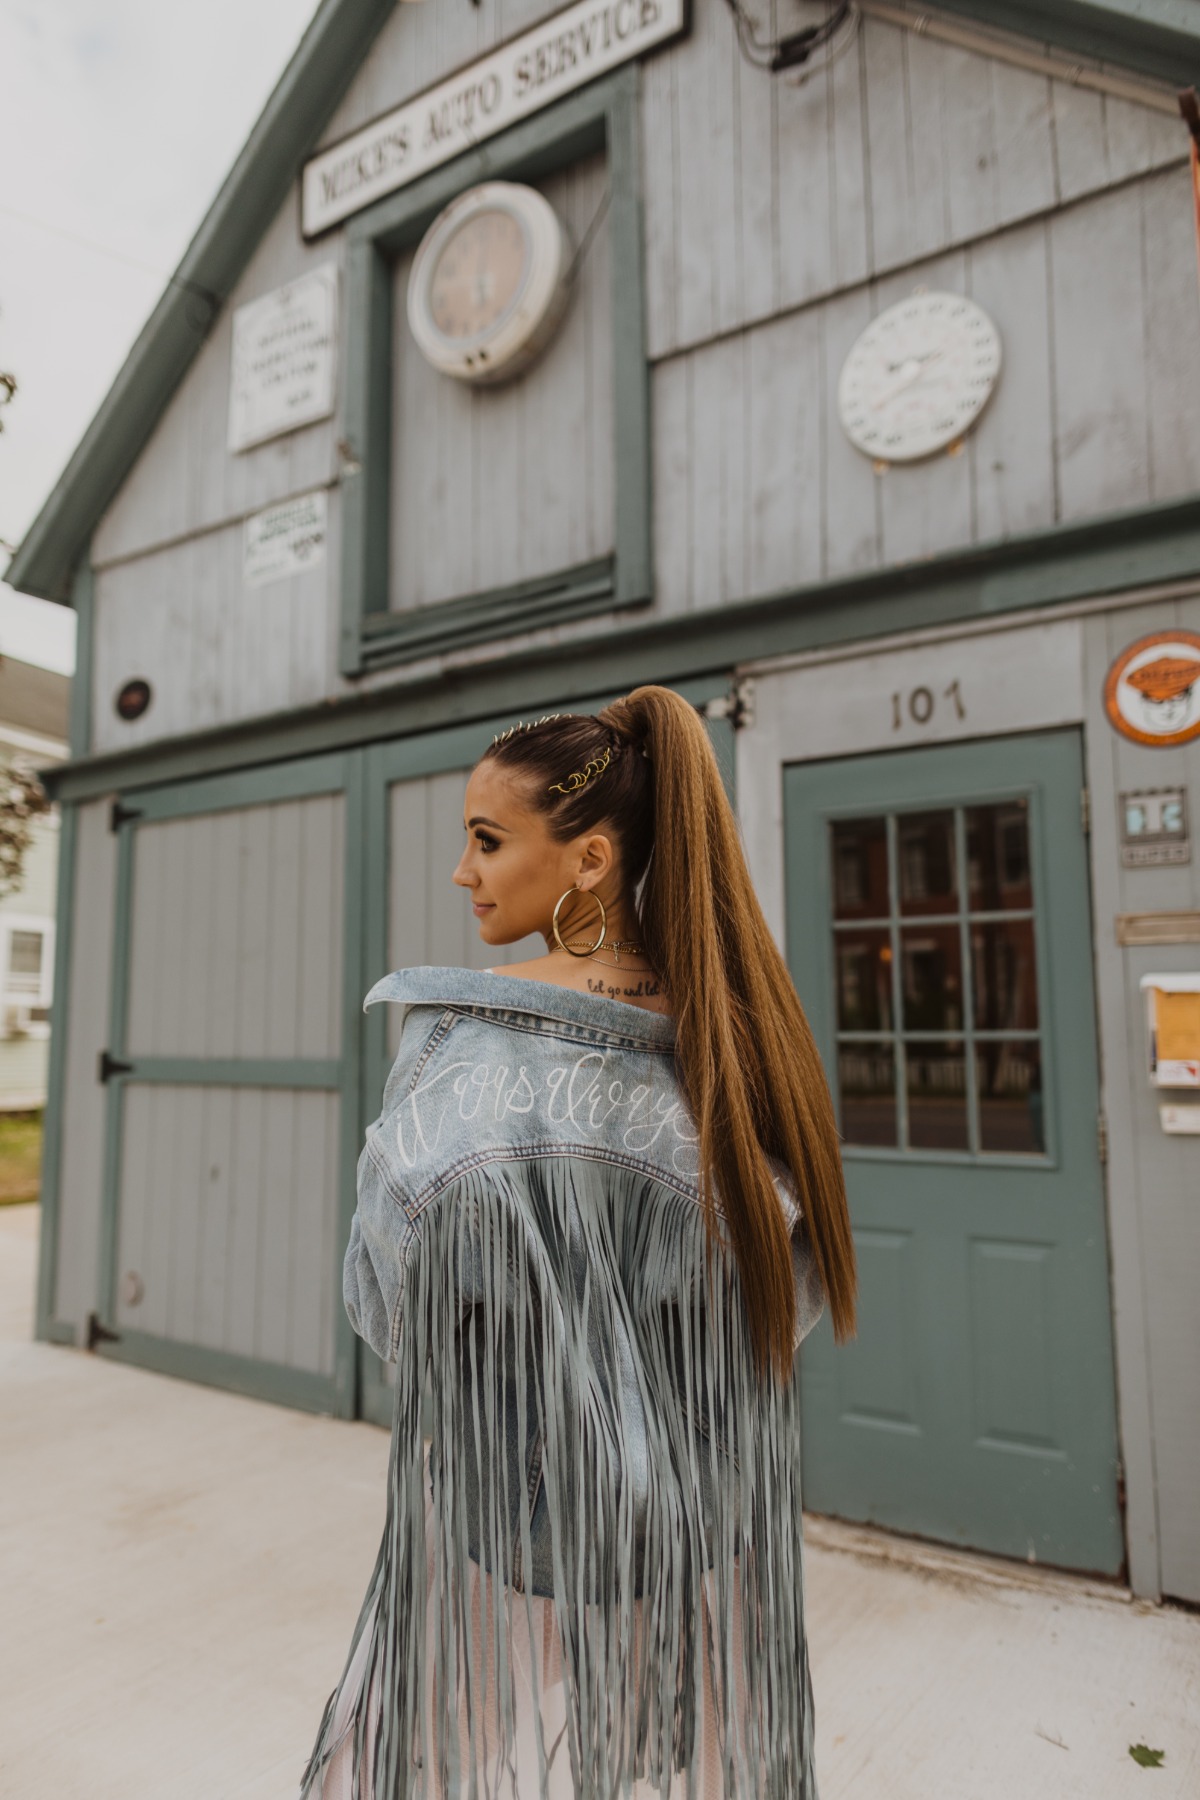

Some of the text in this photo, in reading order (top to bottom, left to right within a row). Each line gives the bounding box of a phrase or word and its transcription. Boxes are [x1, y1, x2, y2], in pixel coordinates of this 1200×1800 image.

[422, 74, 503, 150] AUTO
[512, 0, 662, 98] SERVICE
[890, 678, 968, 734] 101
[587, 978, 605, 994] let
[607, 985, 620, 1000] go
[623, 981, 644, 997] and
